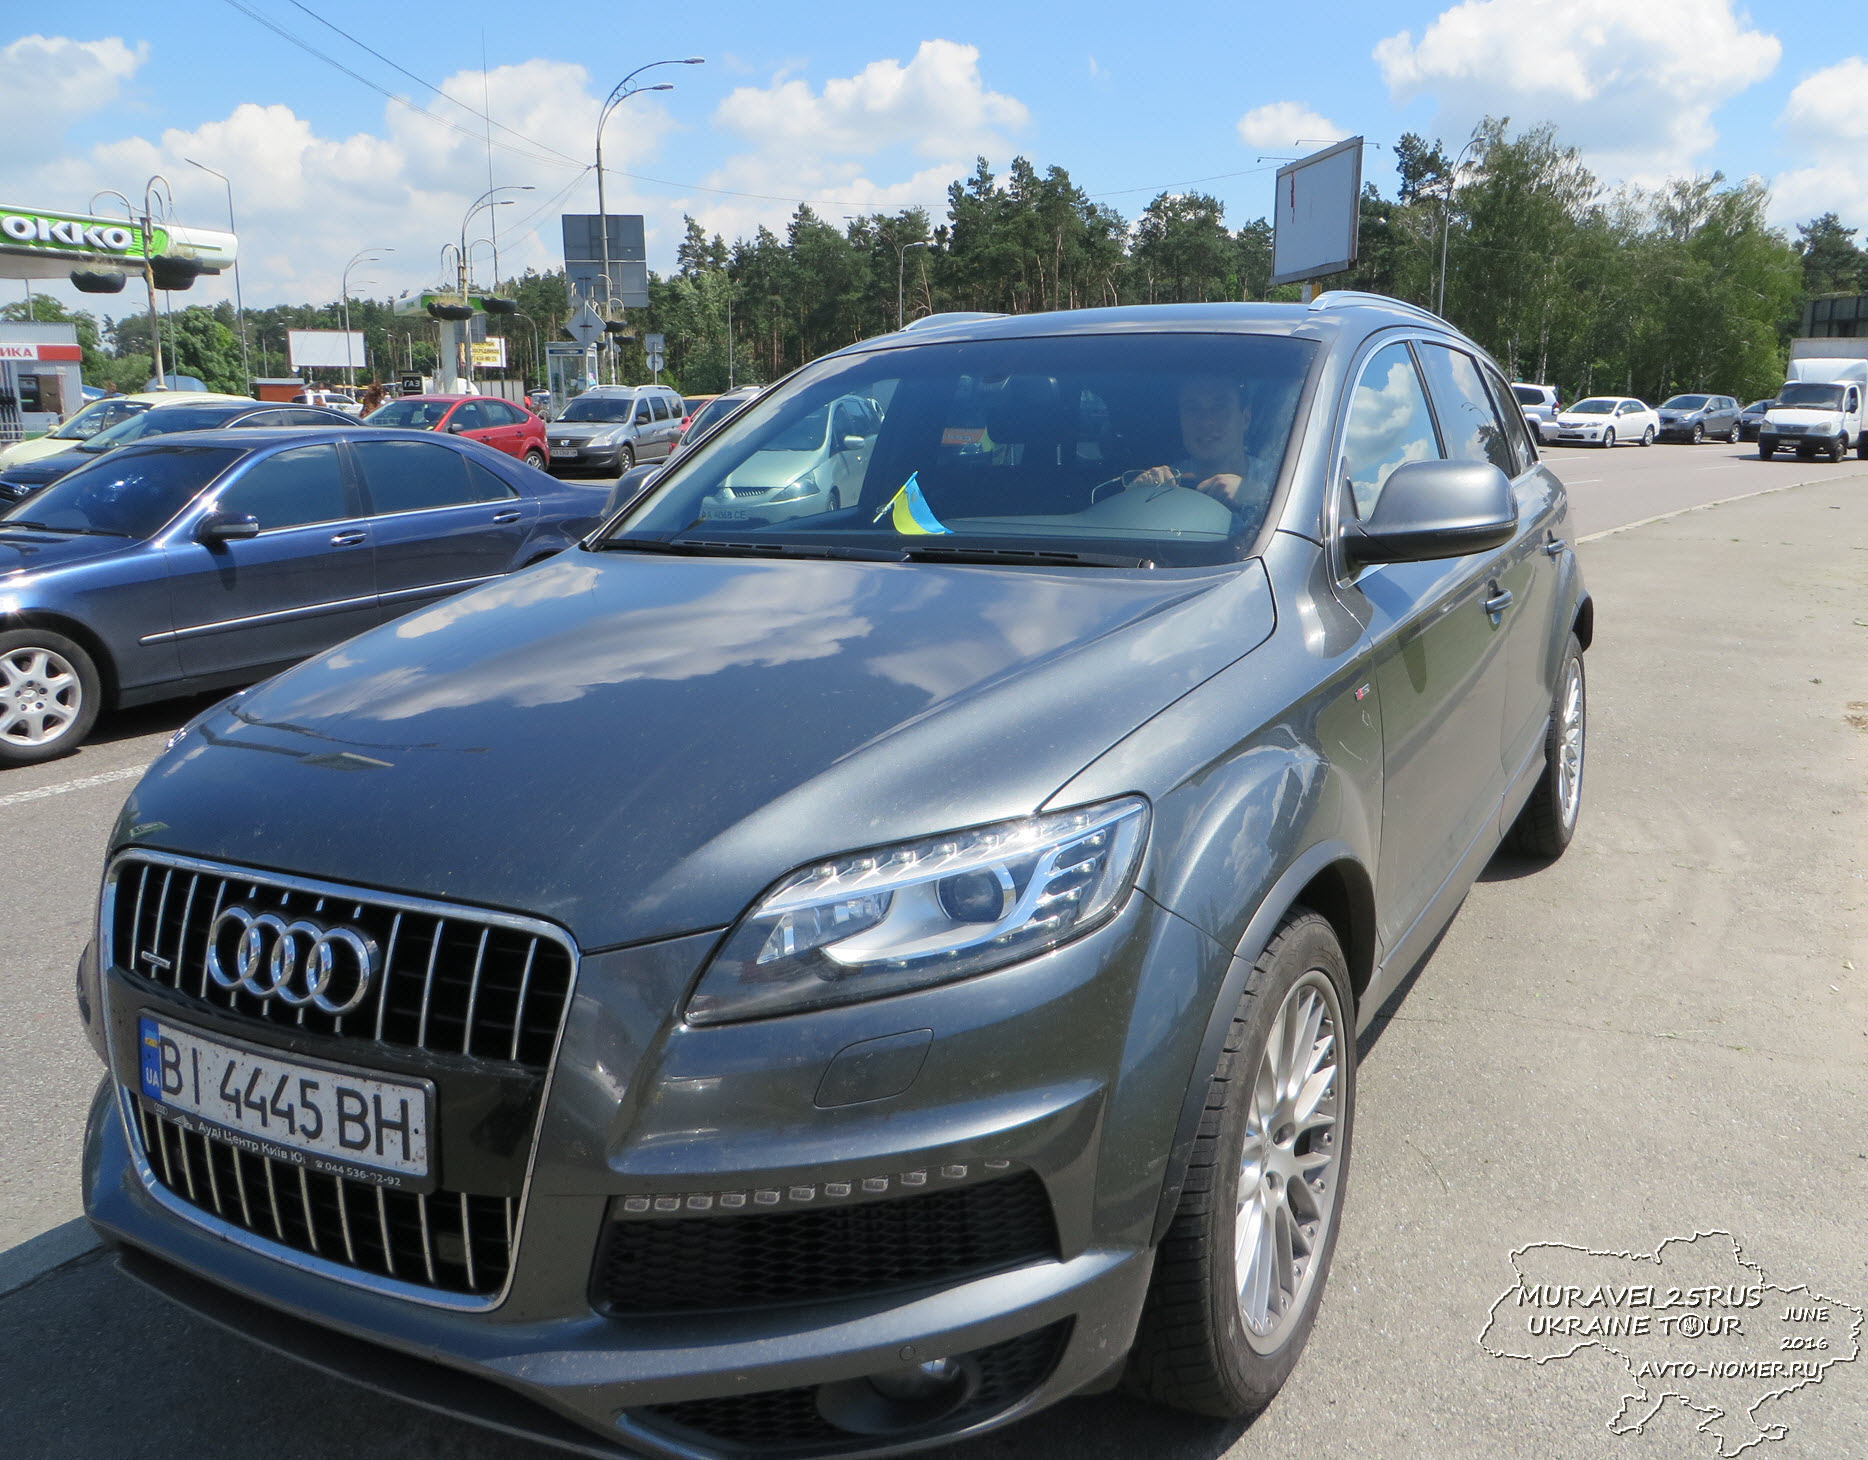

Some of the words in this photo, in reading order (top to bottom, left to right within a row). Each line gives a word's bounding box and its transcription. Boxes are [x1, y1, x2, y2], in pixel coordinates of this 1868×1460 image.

[2, 215, 133, 250] OKKO
[146, 1067, 160, 1087] UA
[160, 1035, 200, 1105] BI
[219, 1060, 323, 1140] 4445
[336, 1086, 411, 1161] BH
[198, 1122, 221, 1139] Ауді
[223, 1130, 259, 1152] Центр
[261, 1142, 288, 1159] Київ
[325, 1162, 344, 1174] 044
